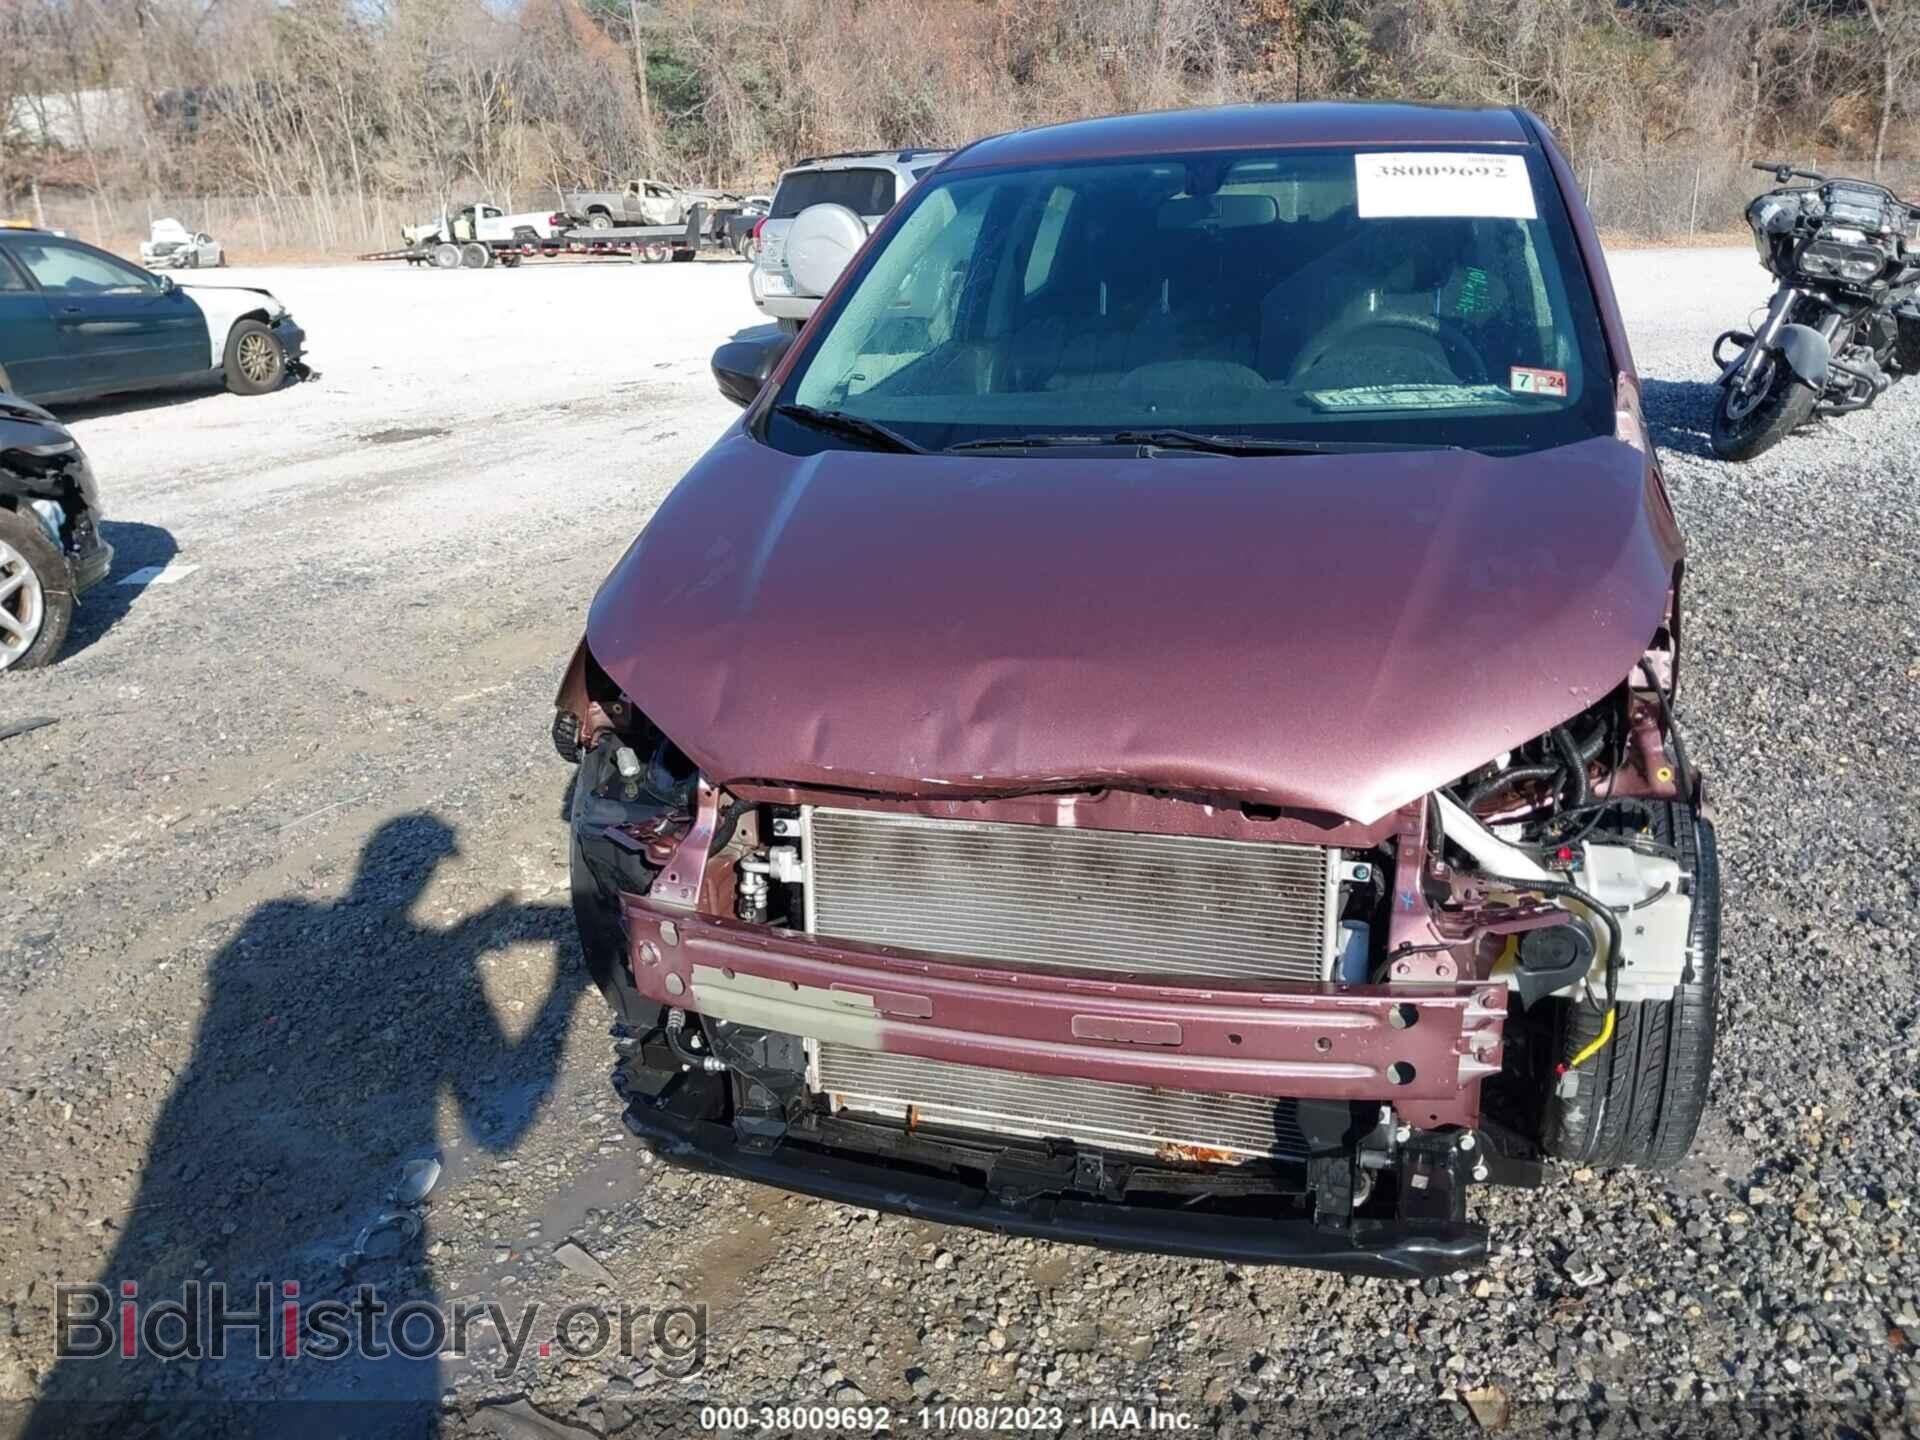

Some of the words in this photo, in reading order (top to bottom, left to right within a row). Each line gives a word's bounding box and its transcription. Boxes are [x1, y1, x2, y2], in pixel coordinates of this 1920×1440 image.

[1375, 164, 1508, 179] 38009692
[1518, 373, 1530, 388] 7
[1548, 375, 1565, 388] 24
